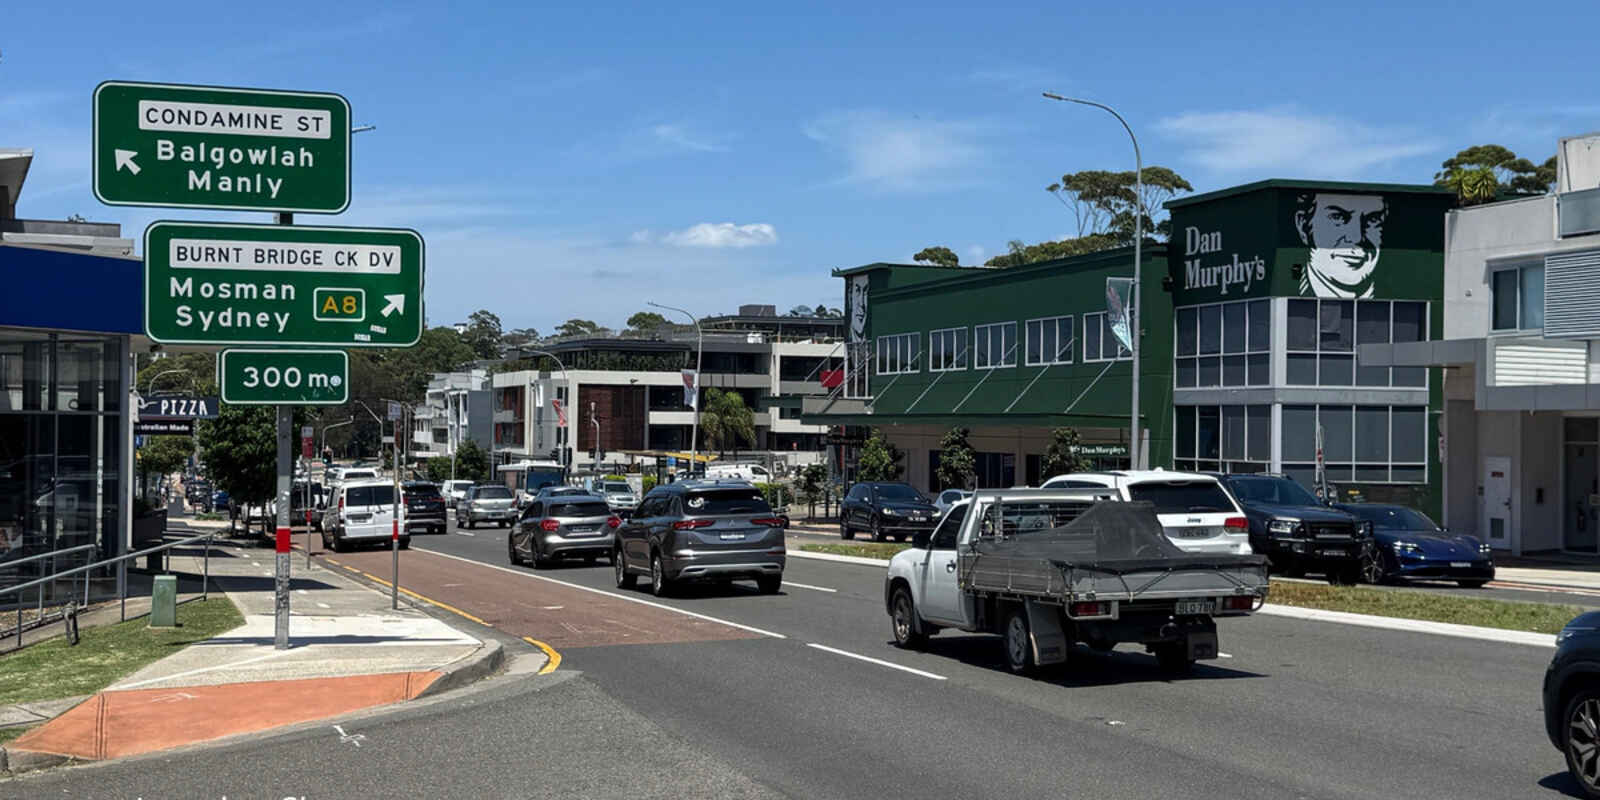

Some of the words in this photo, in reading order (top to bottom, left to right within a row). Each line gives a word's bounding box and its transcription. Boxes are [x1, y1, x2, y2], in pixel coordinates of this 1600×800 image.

[146, 107, 283, 130] CONDAMINE
[297, 116, 324, 132] ST
[157, 139, 314, 169] Balgowlah
[188, 170, 283, 199] Manly
[1184, 226, 1223, 255] Dan
[176, 246, 243, 263] BURNT
[254, 248, 323, 265] BRIDGE
[335, 250, 358, 267] CK
[369, 252, 394, 267] DV
[1184, 253, 1265, 295] Murphy's
[170, 277, 296, 300] Mosman
[322, 295, 357, 314] A8
[176, 305, 290, 333] Sydney
[242, 366, 301, 388] 300
[308, 371, 329, 388] m
[161, 399, 208, 416] PIZZA
